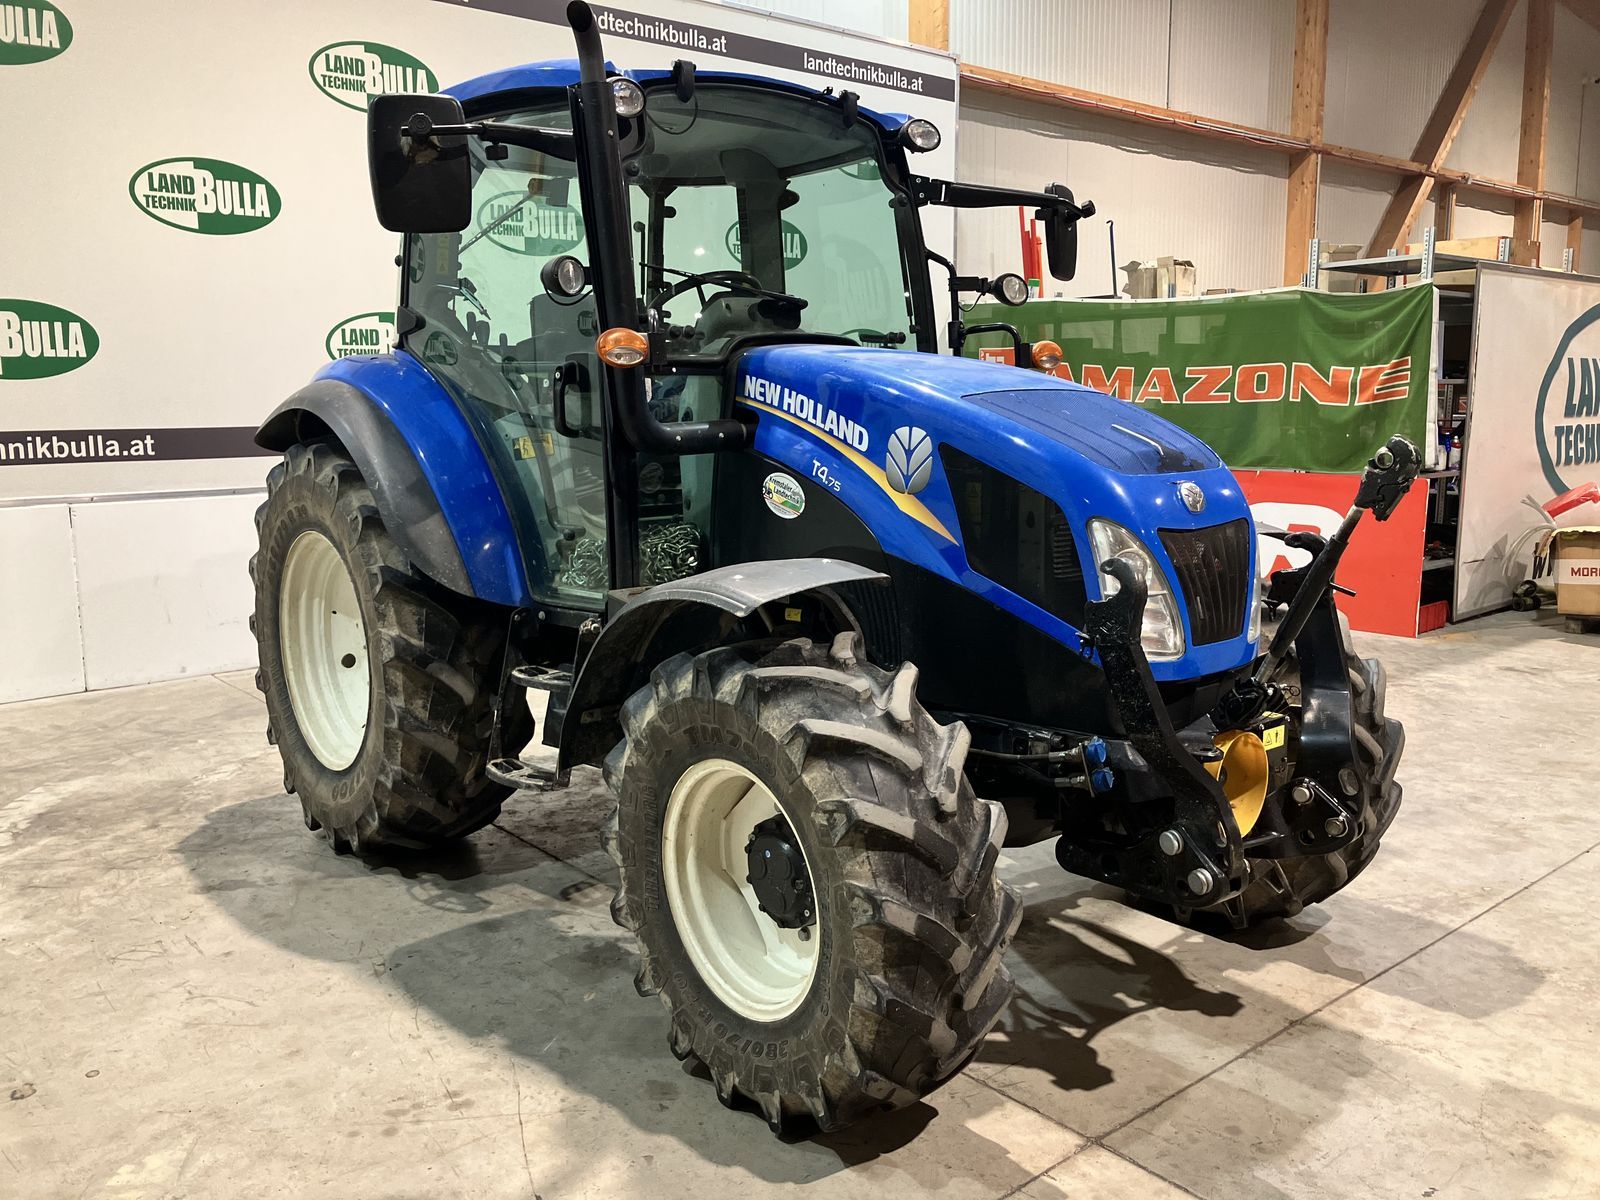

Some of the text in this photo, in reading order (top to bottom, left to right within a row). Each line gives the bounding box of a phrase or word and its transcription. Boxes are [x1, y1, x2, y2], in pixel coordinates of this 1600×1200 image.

[593, 12, 727, 52] dtechnikbulla.at
[320, 74, 366, 92] TECHNIK
[325, 53, 365, 77] LAND
[365, 52, 429, 94] BULLA
[803, 52, 923, 92] landtechnikbulla.at
[143, 194, 197, 212] TECHNIK
[147, 172, 195, 195] LAND
[195, 168, 271, 218] BULLA
[524, 200, 578, 240] BULLA
[0, 311, 87, 358] BULLA
[341, 328, 379, 346] LAND
[744, 374, 869, 452] NEW HOLLAND
[1555, 423, 1600, 467] TECH
[812, 459, 842, 492] T4.75
[1571, 566, 1600, 577] MOR
